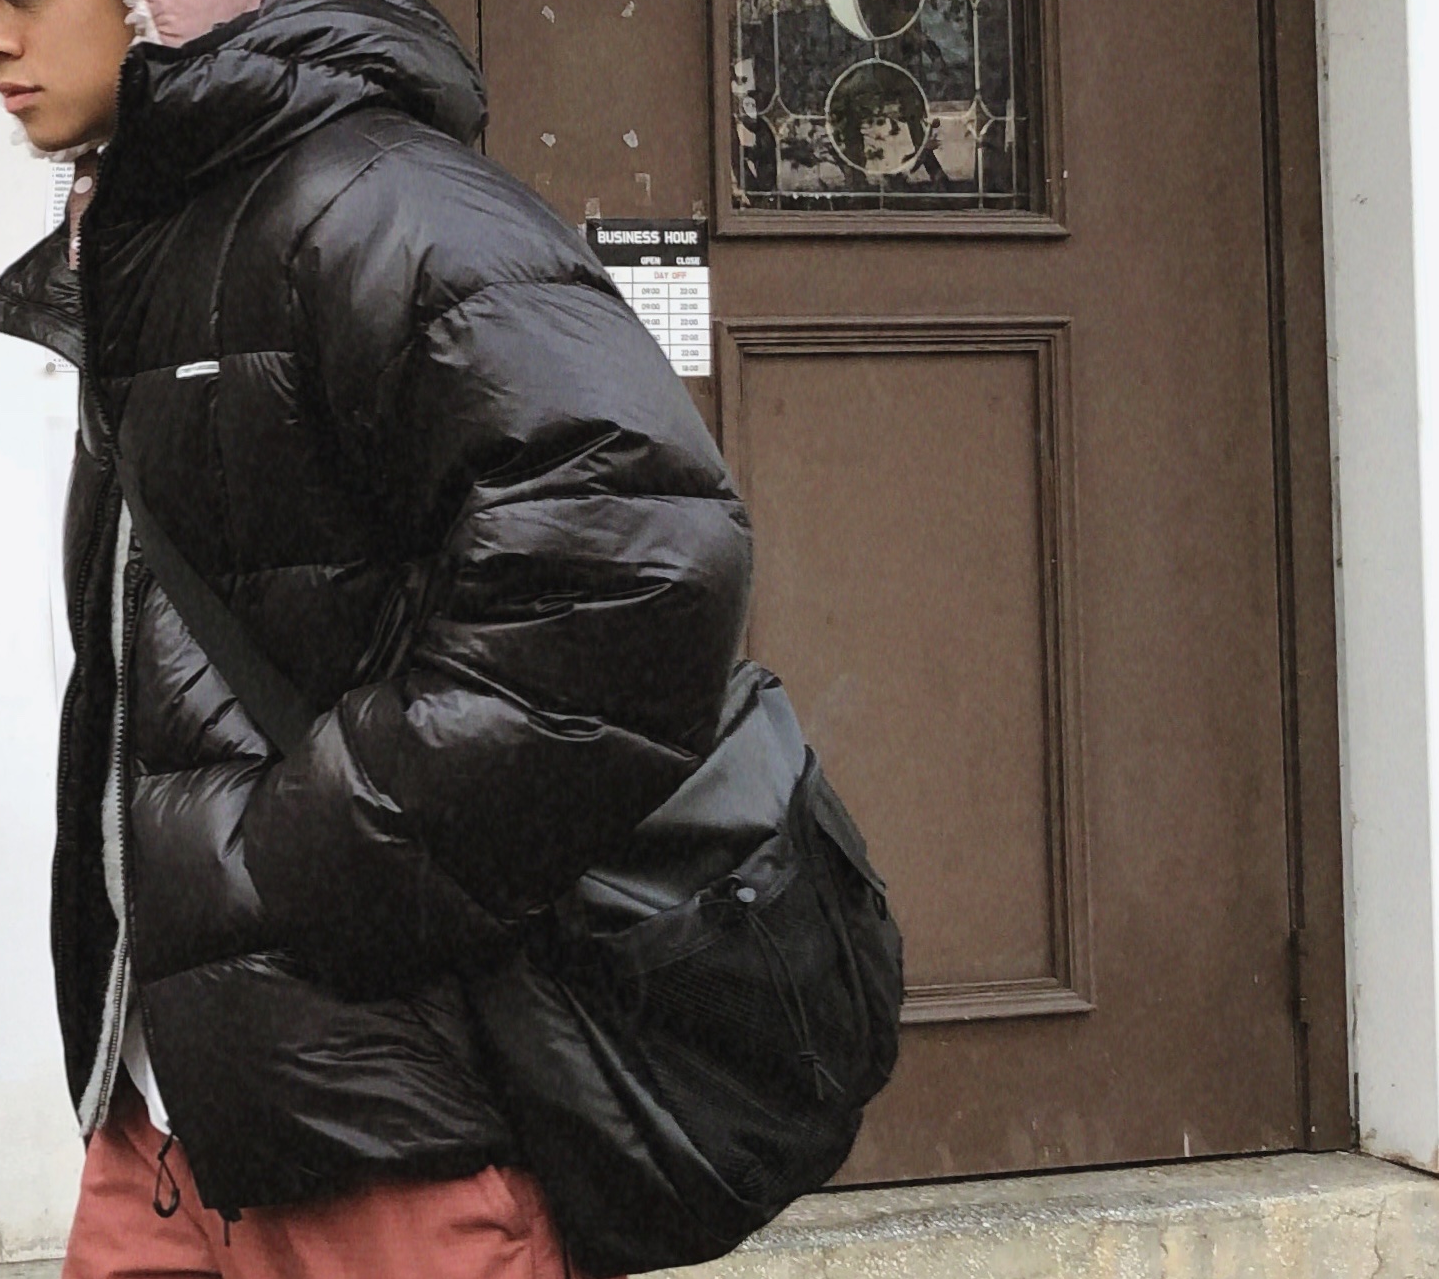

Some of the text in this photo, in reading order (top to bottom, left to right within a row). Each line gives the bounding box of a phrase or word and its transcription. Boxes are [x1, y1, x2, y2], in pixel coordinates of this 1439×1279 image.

[597, 230, 698, 245] BUSINESS HOUR
[640, 256, 701, 266] OPEN CLOSE
[654, 271, 687, 280] DAY OFF
